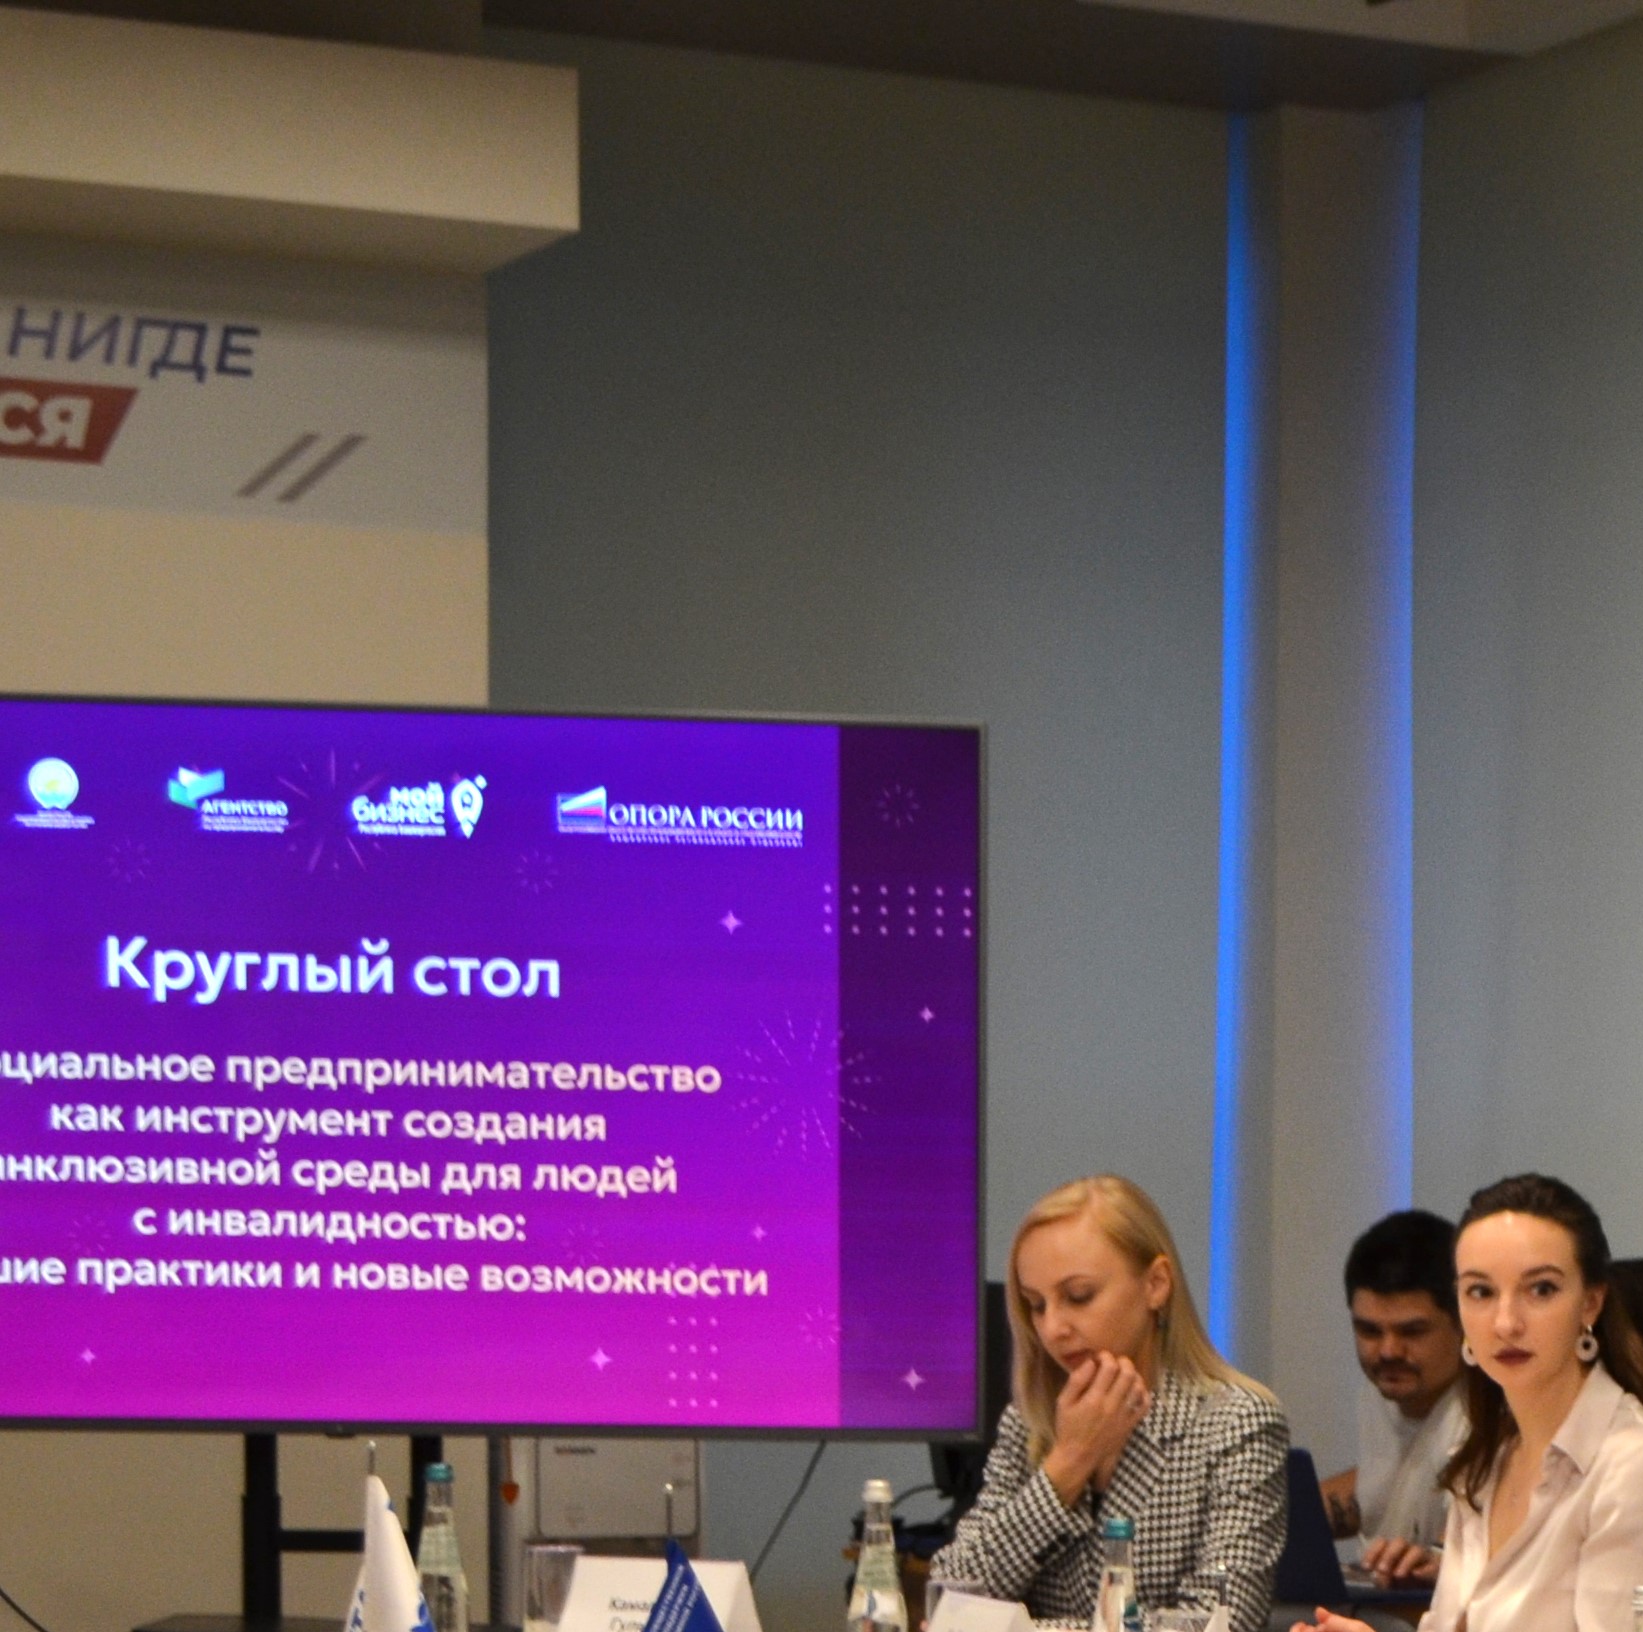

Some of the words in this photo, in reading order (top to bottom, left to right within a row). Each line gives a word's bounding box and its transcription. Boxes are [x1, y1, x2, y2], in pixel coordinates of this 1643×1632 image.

[6, 307, 260, 383] НИГДЕ
[608, 802, 696, 828] ОПОРА
[700, 805, 804, 832] РОССИИ
[106, 935, 395, 1005] Круглый
[413, 955, 561, 999] стол
[0, 1050, 216, 1085] циальное
[226, 1056, 723, 1094] предпринимательство
[50, 1102, 125, 1133] как
[135, 1104, 394, 1144] инструмент
[403, 1110, 607, 1145] создания
[291, 1158, 431, 1195] среды
[441, 1161, 523, 1195] для
[533, 1155, 678, 1199] людей
[133, 1207, 158, 1236] с
[168, 1208, 528, 1244] инвалидностью:
[77, 1258, 283, 1294] практики
[295, 1261, 320, 1289] и
[332, 1261, 470, 1292] новые
[481, 1264, 769, 1298] возможности
